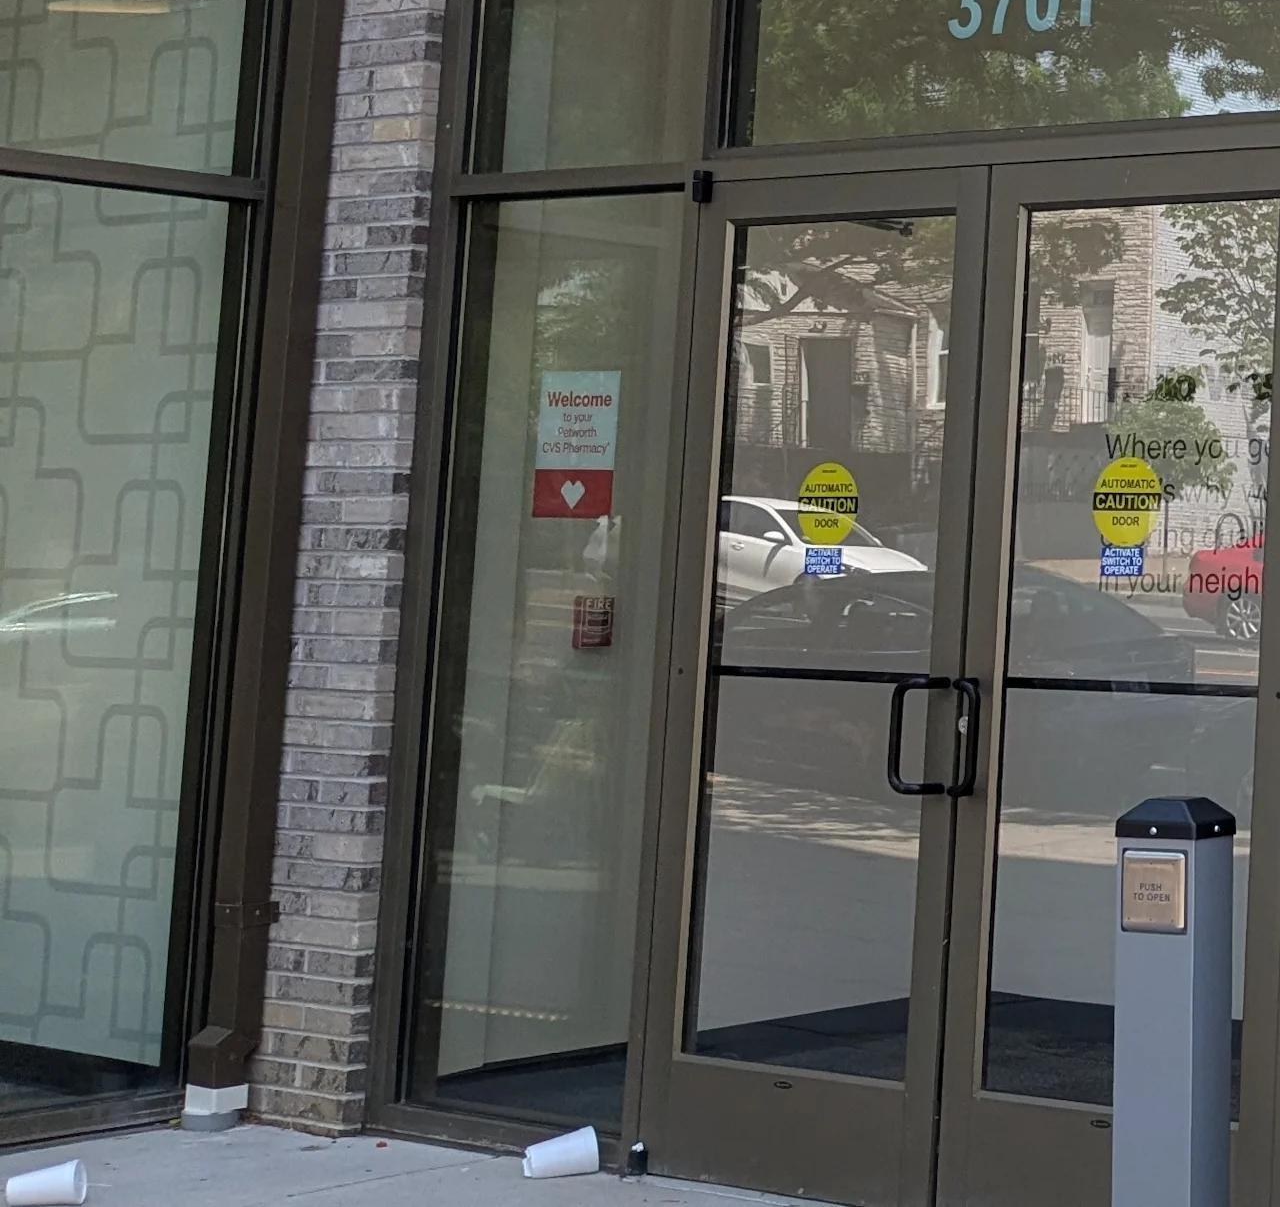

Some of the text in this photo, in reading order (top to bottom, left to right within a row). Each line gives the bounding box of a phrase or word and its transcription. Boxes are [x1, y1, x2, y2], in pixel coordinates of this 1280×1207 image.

[547, 391, 612, 407] Welcome
[563, 413, 593, 425] to your
[558, 426, 597, 438] Petworth
[542, 441, 560, 453] CVS
[1105, 433, 1187, 459] Where
[1194, 438, 1238, 465] you
[805, 483, 853, 493] AUTOMATIC
[1101, 479, 1156, 489] AUTOMATIC
[800, 498, 856, 513] CAUTION
[1095, 494, 1159, 510] CAUTION
[814, 519, 839, 528] DOOR
[1112, 516, 1140, 526] DOOR
[808, 548, 839, 557] ACTIVATE
[1105, 548, 1140, 557] ACTIVATE
[805, 556, 841, 565] SWITCH TO
[1102, 556, 1142, 566] SWITCH TO
[807, 565, 838, 574] OPERATE
[1104, 566, 1139, 575] OPERATE
[1127, 572, 1183, 599] your
[586, 599, 612, 610] FIRE
[1140, 882, 1162, 891] PUSH
[1133, 892, 1171, 902] TO OPEN
